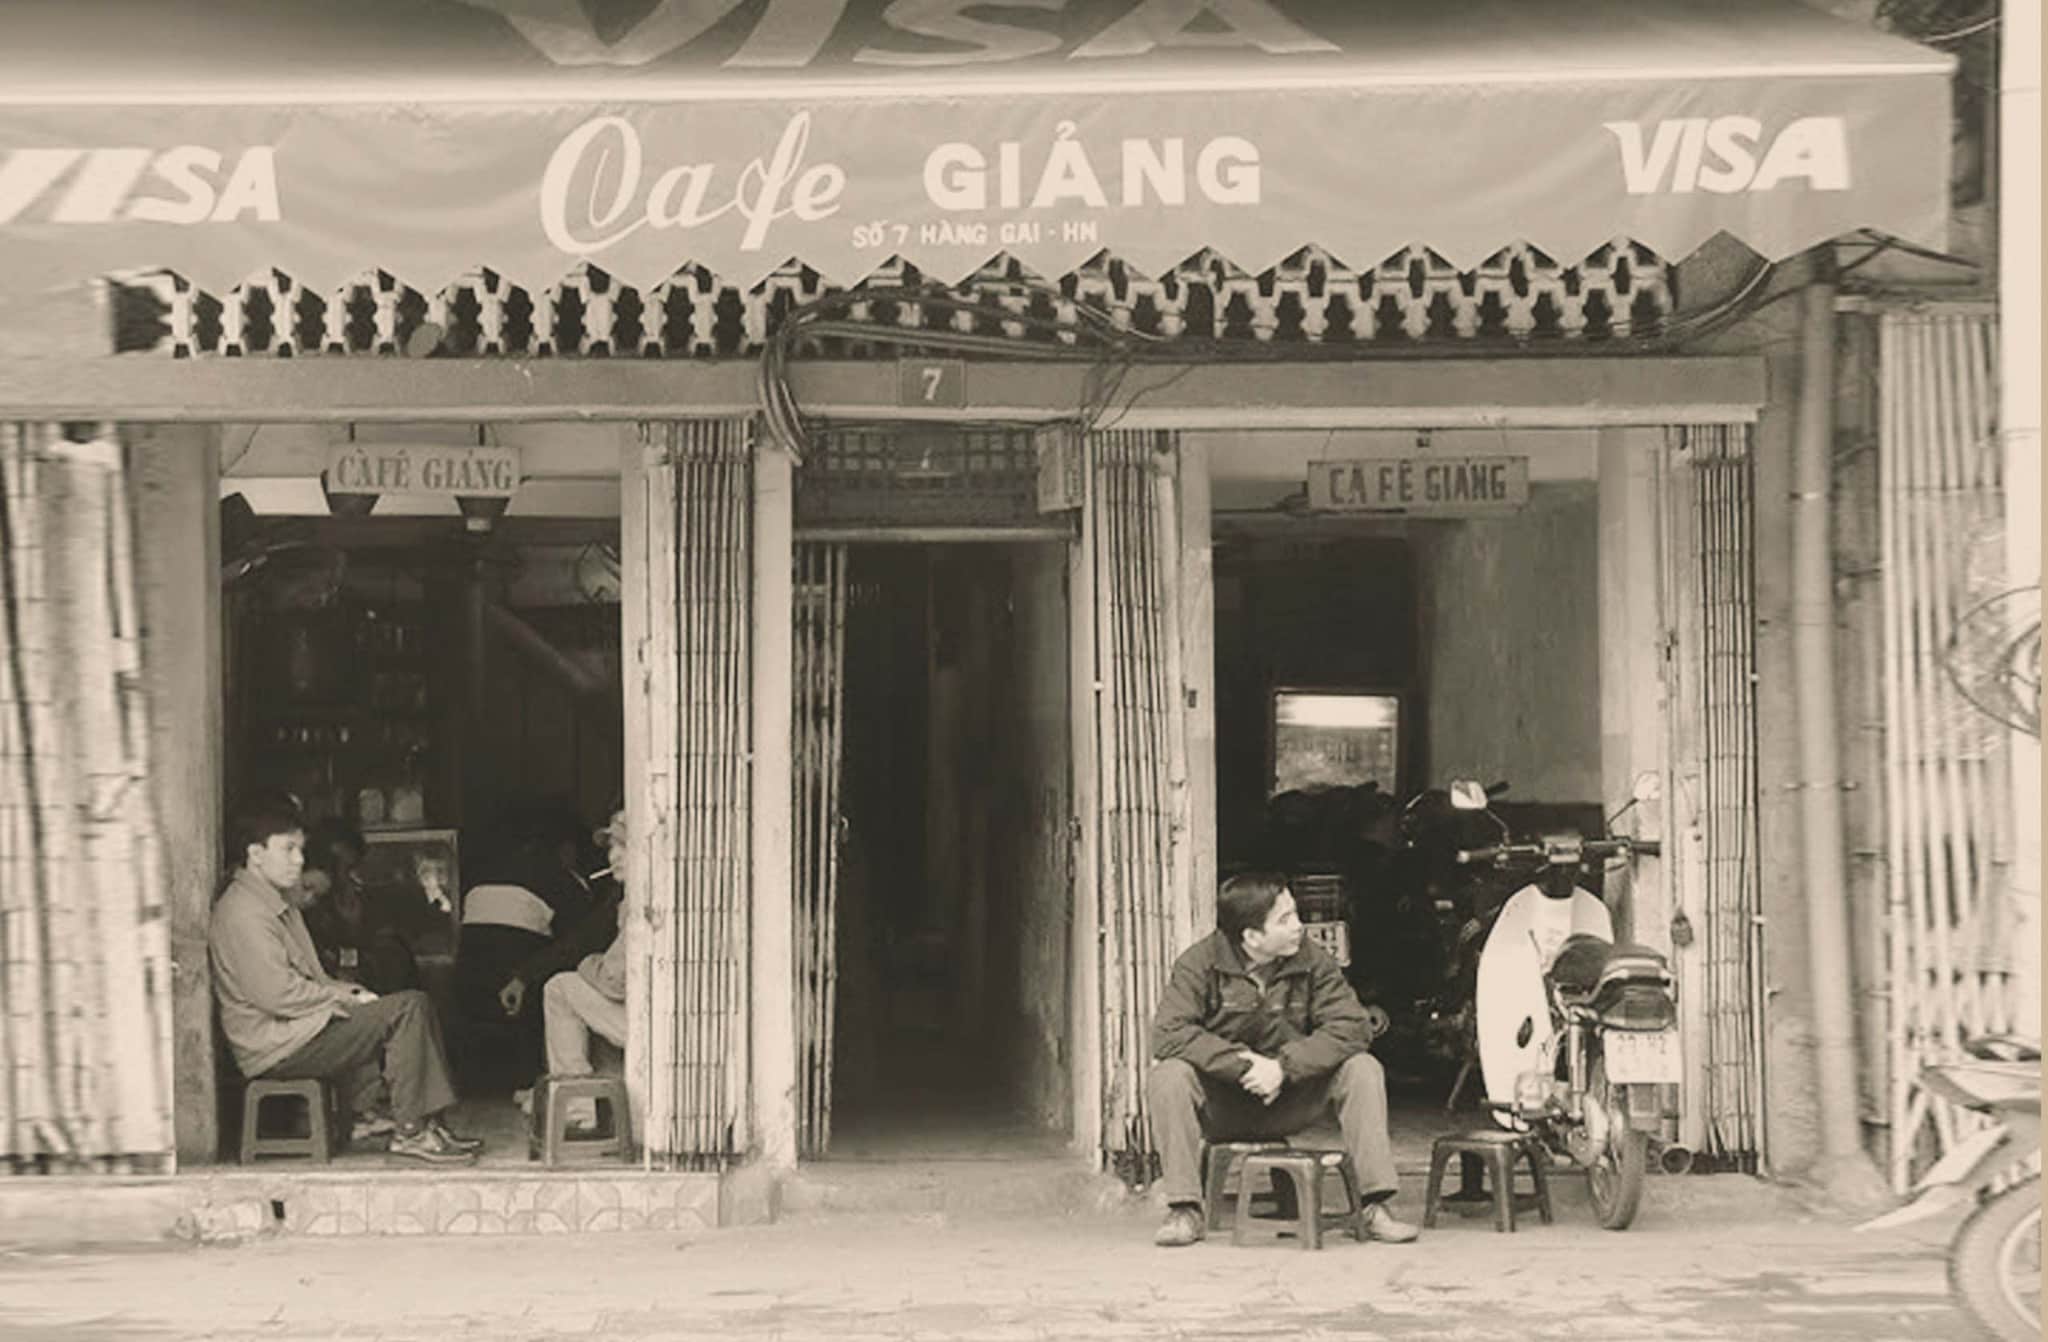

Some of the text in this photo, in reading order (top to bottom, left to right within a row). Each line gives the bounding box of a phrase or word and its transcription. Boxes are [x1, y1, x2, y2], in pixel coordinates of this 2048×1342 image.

[923, 120, 1261, 211] GIẢNG
[1603, 116, 1851, 194] VISA
[892, 224, 909, 246] 7
[920, 219, 988, 246] HÀNG
[1063, 220, 1098, 243] HN
[922, 367, 942, 400] 7
